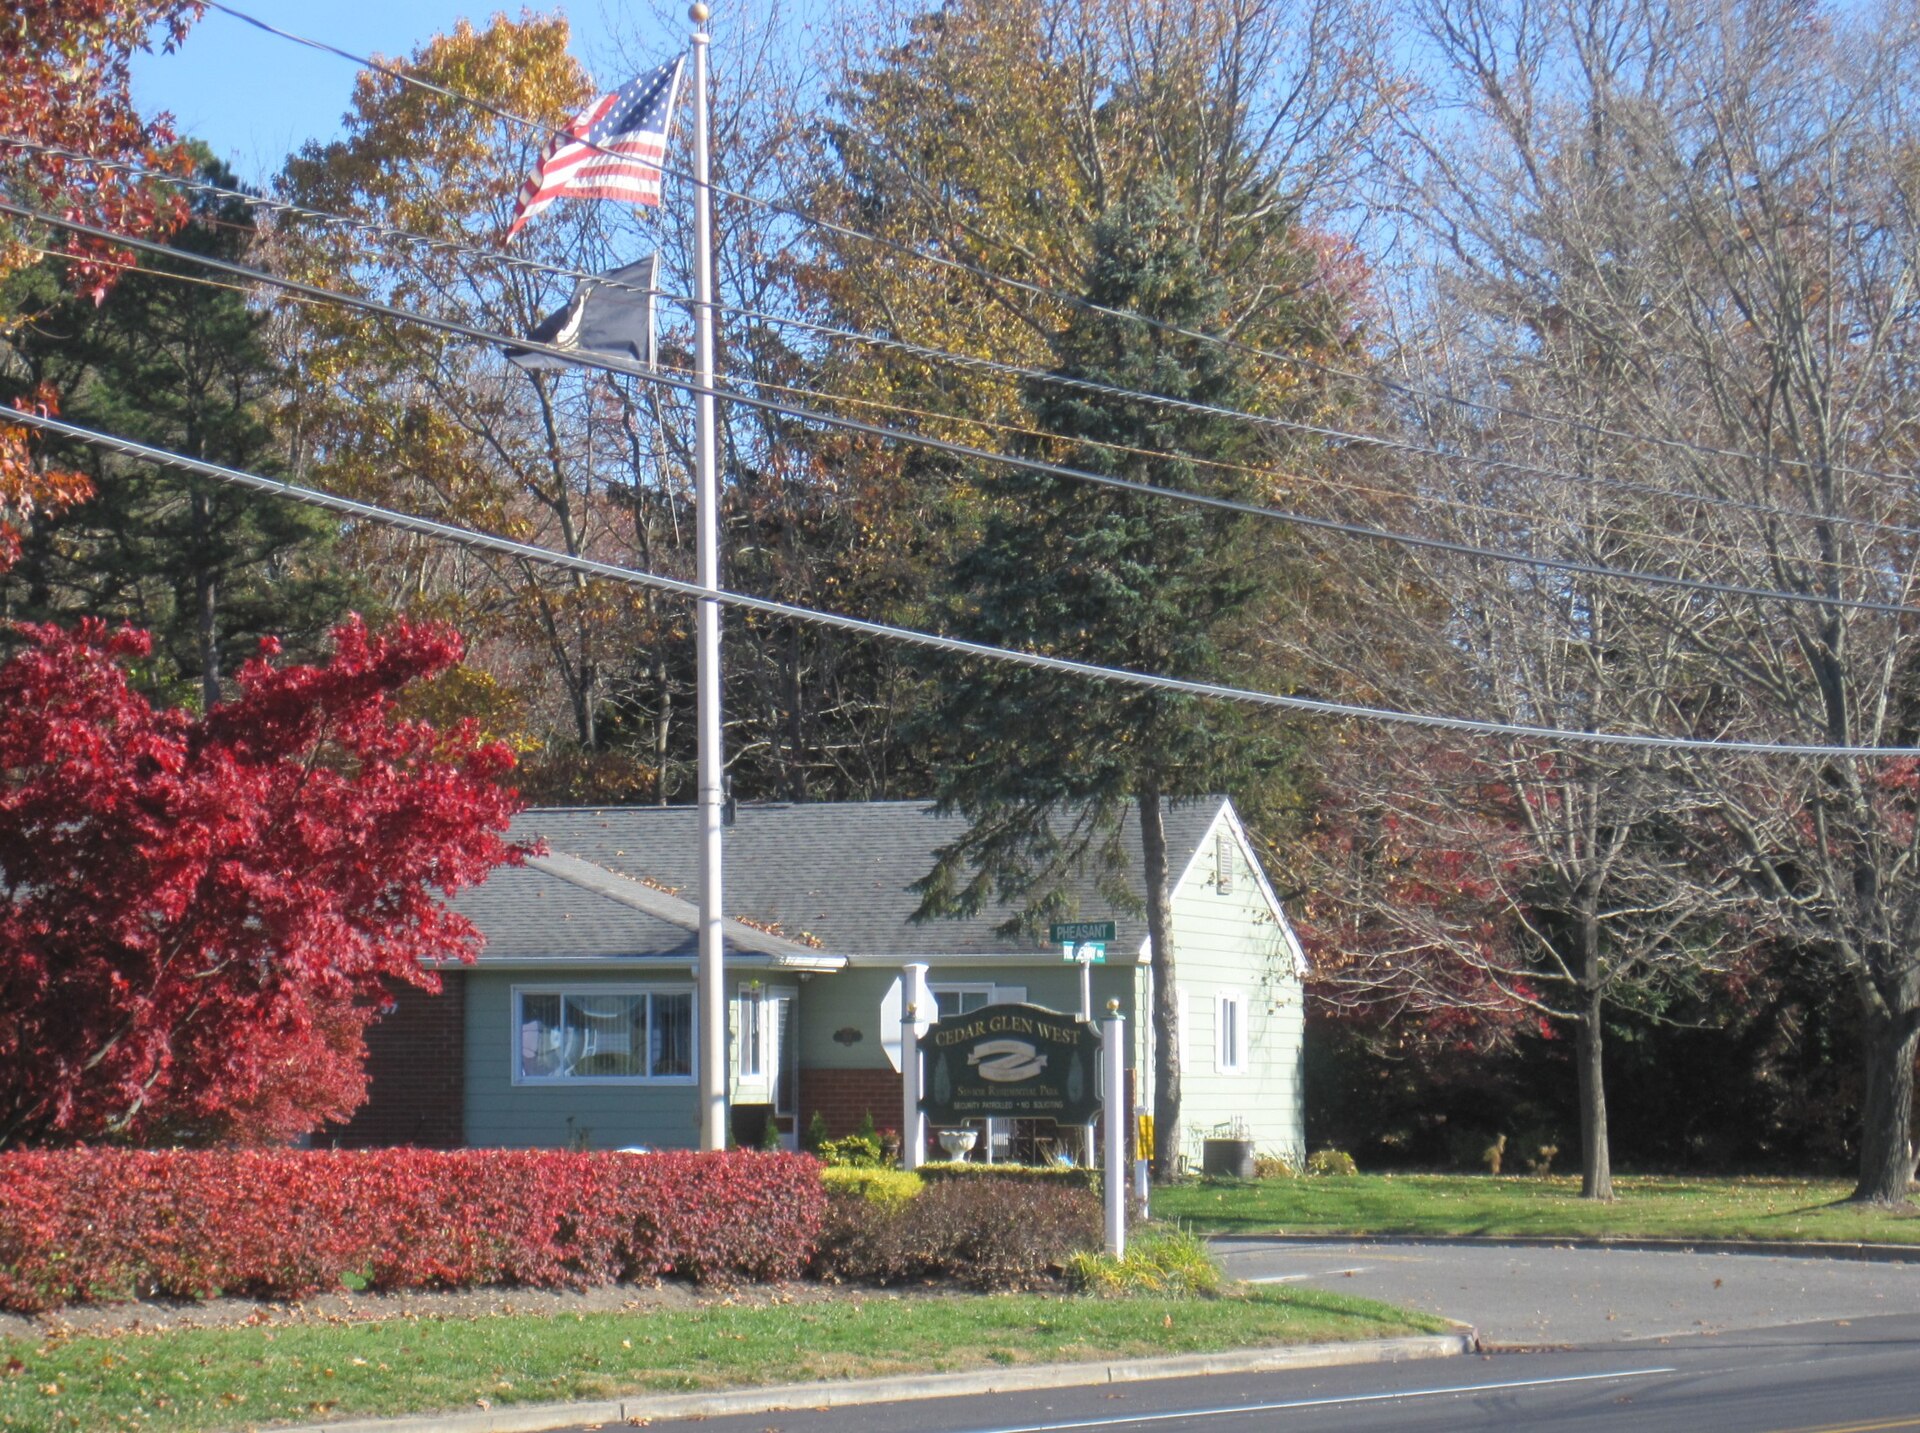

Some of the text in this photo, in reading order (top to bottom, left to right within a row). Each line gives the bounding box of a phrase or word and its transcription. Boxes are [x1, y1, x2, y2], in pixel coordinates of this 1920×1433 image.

[1056, 924, 1107, 939] PHEASANT
[935, 1015, 1081, 1047] CEDAR GLEN WEST
[953, 1101, 980, 1110] SECURITY
[982, 1101, 1013, 1110] PATROLLED
[1021, 1101, 1030, 1109] NO
